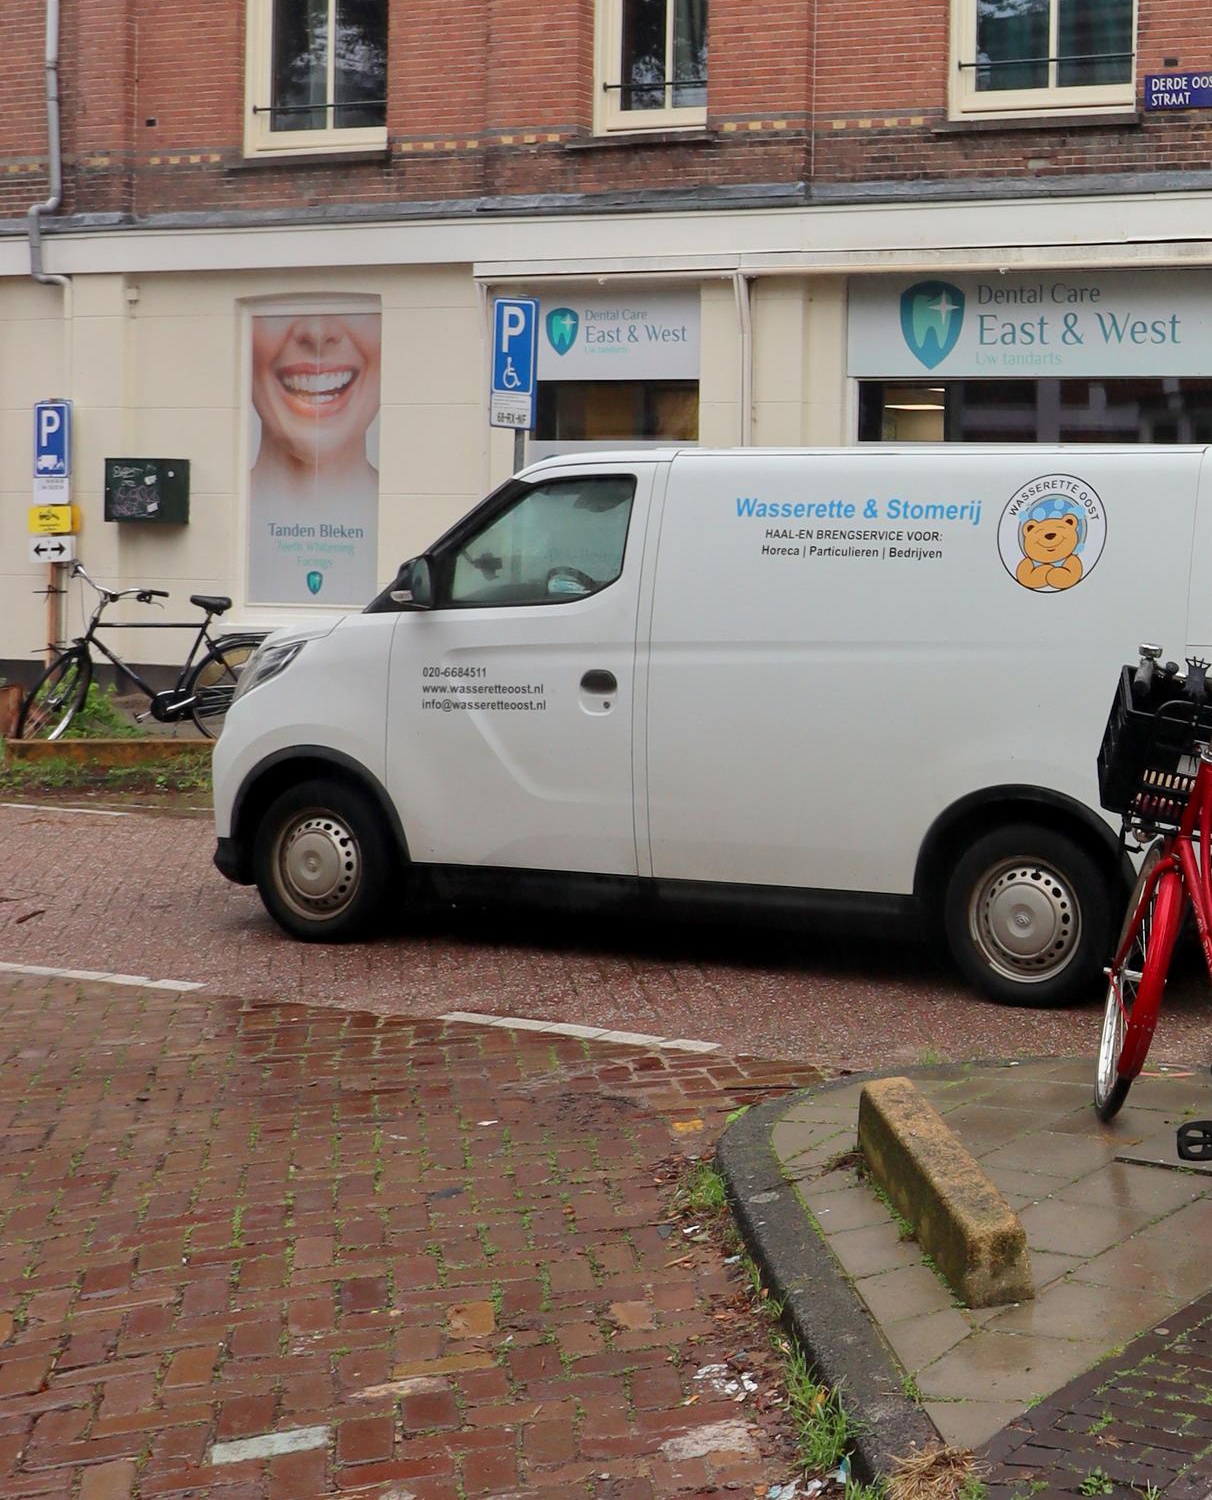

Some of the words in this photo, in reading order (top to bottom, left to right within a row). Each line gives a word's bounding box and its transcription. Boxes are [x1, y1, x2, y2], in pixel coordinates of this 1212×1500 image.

[1151, 76, 1188, 91] DERDE
[1151, 91, 1191, 106] STRAAT
[977, 283, 1043, 305] Dental
[1051, 282, 1101, 303] Care
[584, 308, 619, 321] Dental
[621, 308, 648, 321] Care
[502, 305, 526, 353] P
[585, 325, 622, 344] East
[627, 324, 639, 344] &
[645, 324, 688, 343] West
[977, 313, 1049, 346] East
[1061, 311, 1084, 346] &
[1095, 311, 1182, 345] West
[975, 351, 997, 366] Uw
[1002, 351, 1063, 366] tandarts
[41, 410, 61, 447] P
[1009, 480, 1080, 517] WASSERETTE
[1079, 492, 1100, 520] OOST
[736, 498, 856, 518] Wasserette
[863, 498, 879, 519] &
[886, 498, 982, 526] Stomerij
[268, 522, 316, 538] Tanden
[319, 524, 364, 539] Bleken
[765, 529, 814, 540] HAAL-EN
[816, 529, 904, 541] BRENGSERVICE
[906, 531, 943, 542] VOOR:
[761, 545, 800, 557] Horeca
[809, 546, 879, 558] Particulieren
[889, 547, 943, 560] Bedrijven
[422, 666, 487, 678] 020-6684511
[422, 683, 544, 694] www.wasseretteoost.nl
[422, 699, 546, 713] info@wasseretteoost.nl
